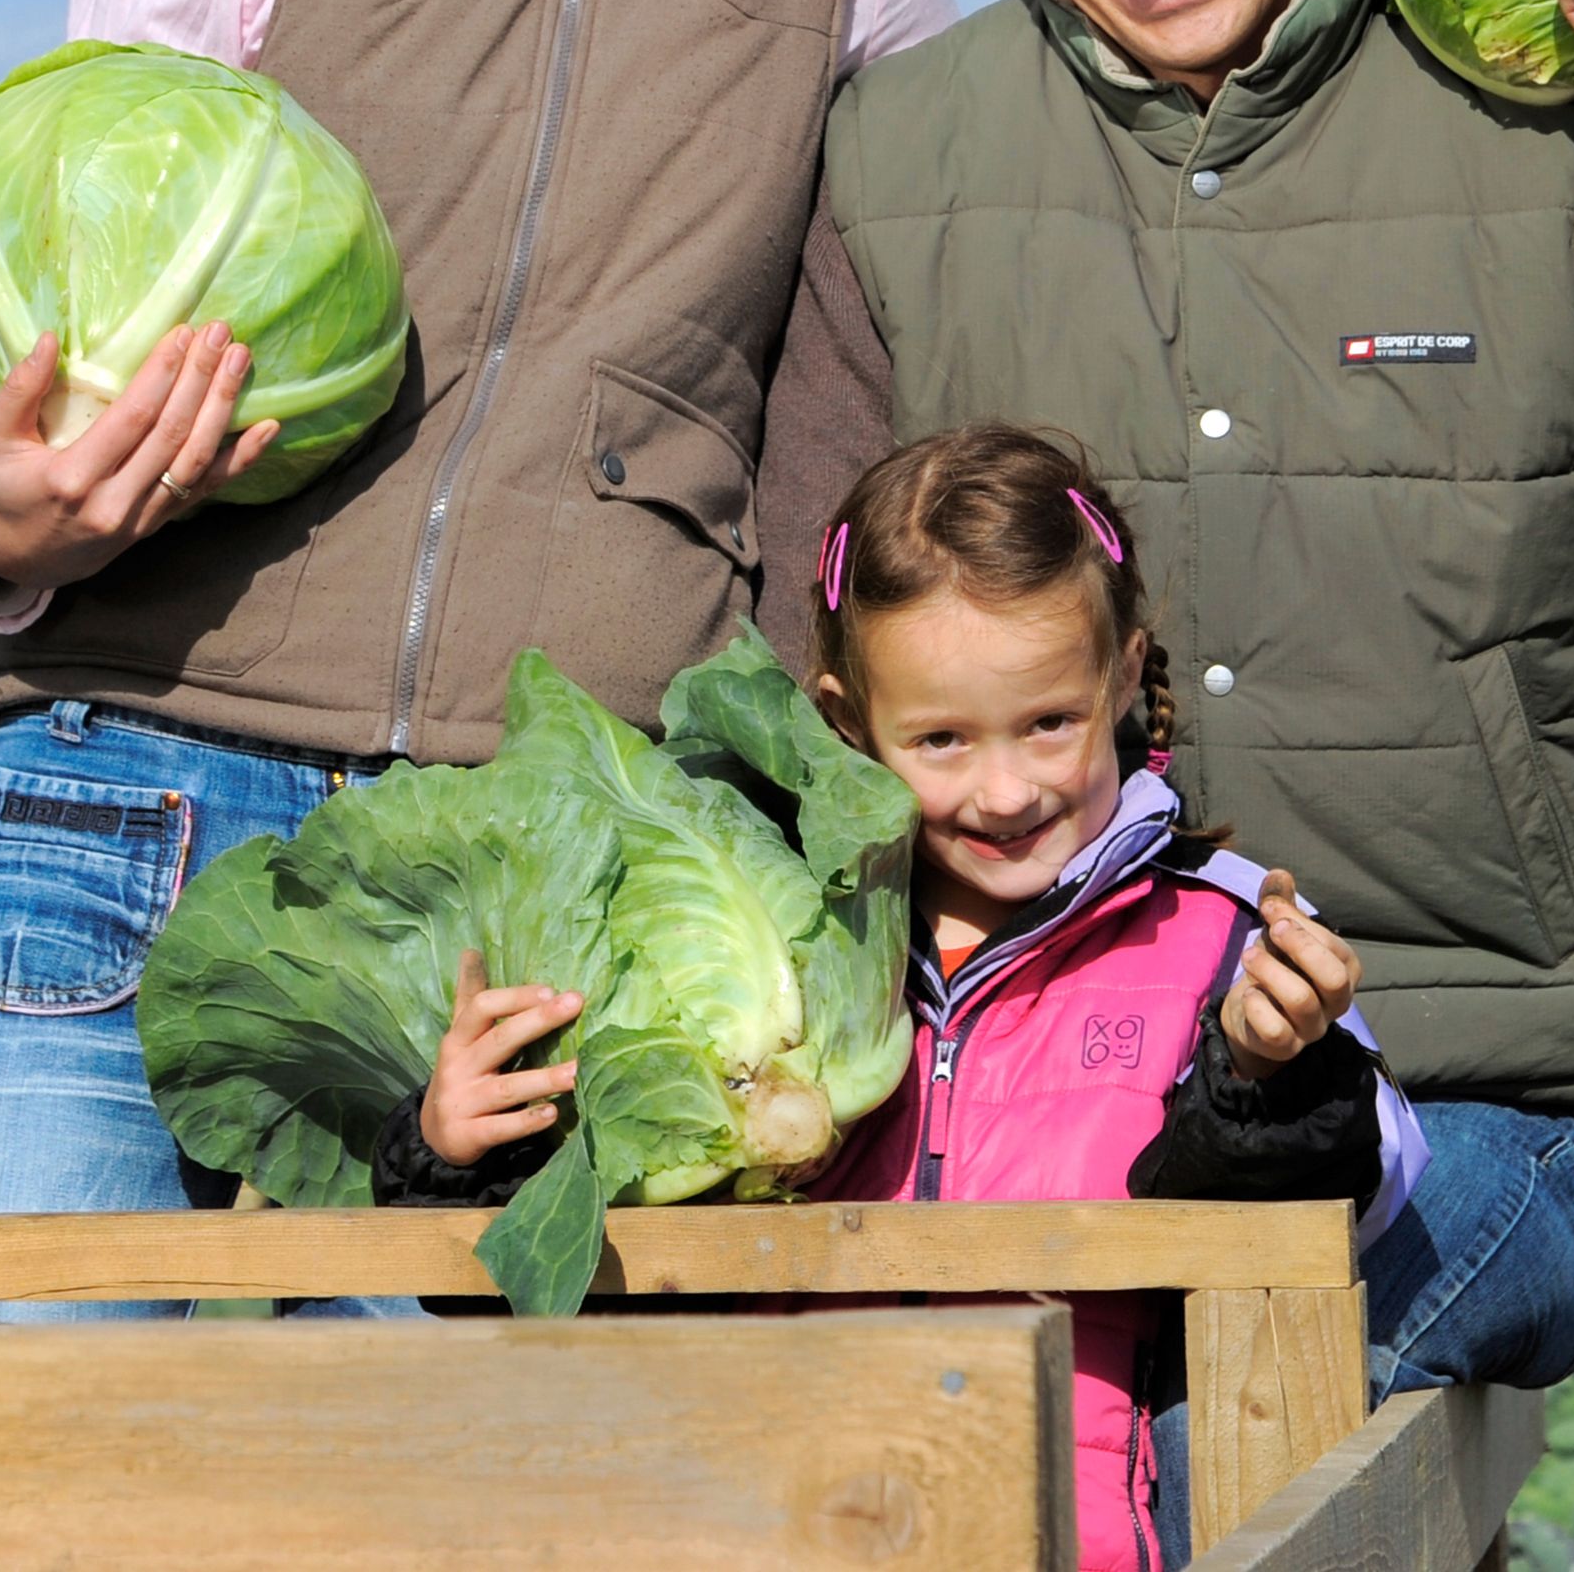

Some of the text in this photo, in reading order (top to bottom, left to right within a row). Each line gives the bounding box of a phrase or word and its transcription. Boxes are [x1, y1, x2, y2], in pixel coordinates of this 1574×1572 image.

[1374, 335, 1471, 348] ESPRIT DE CORP
